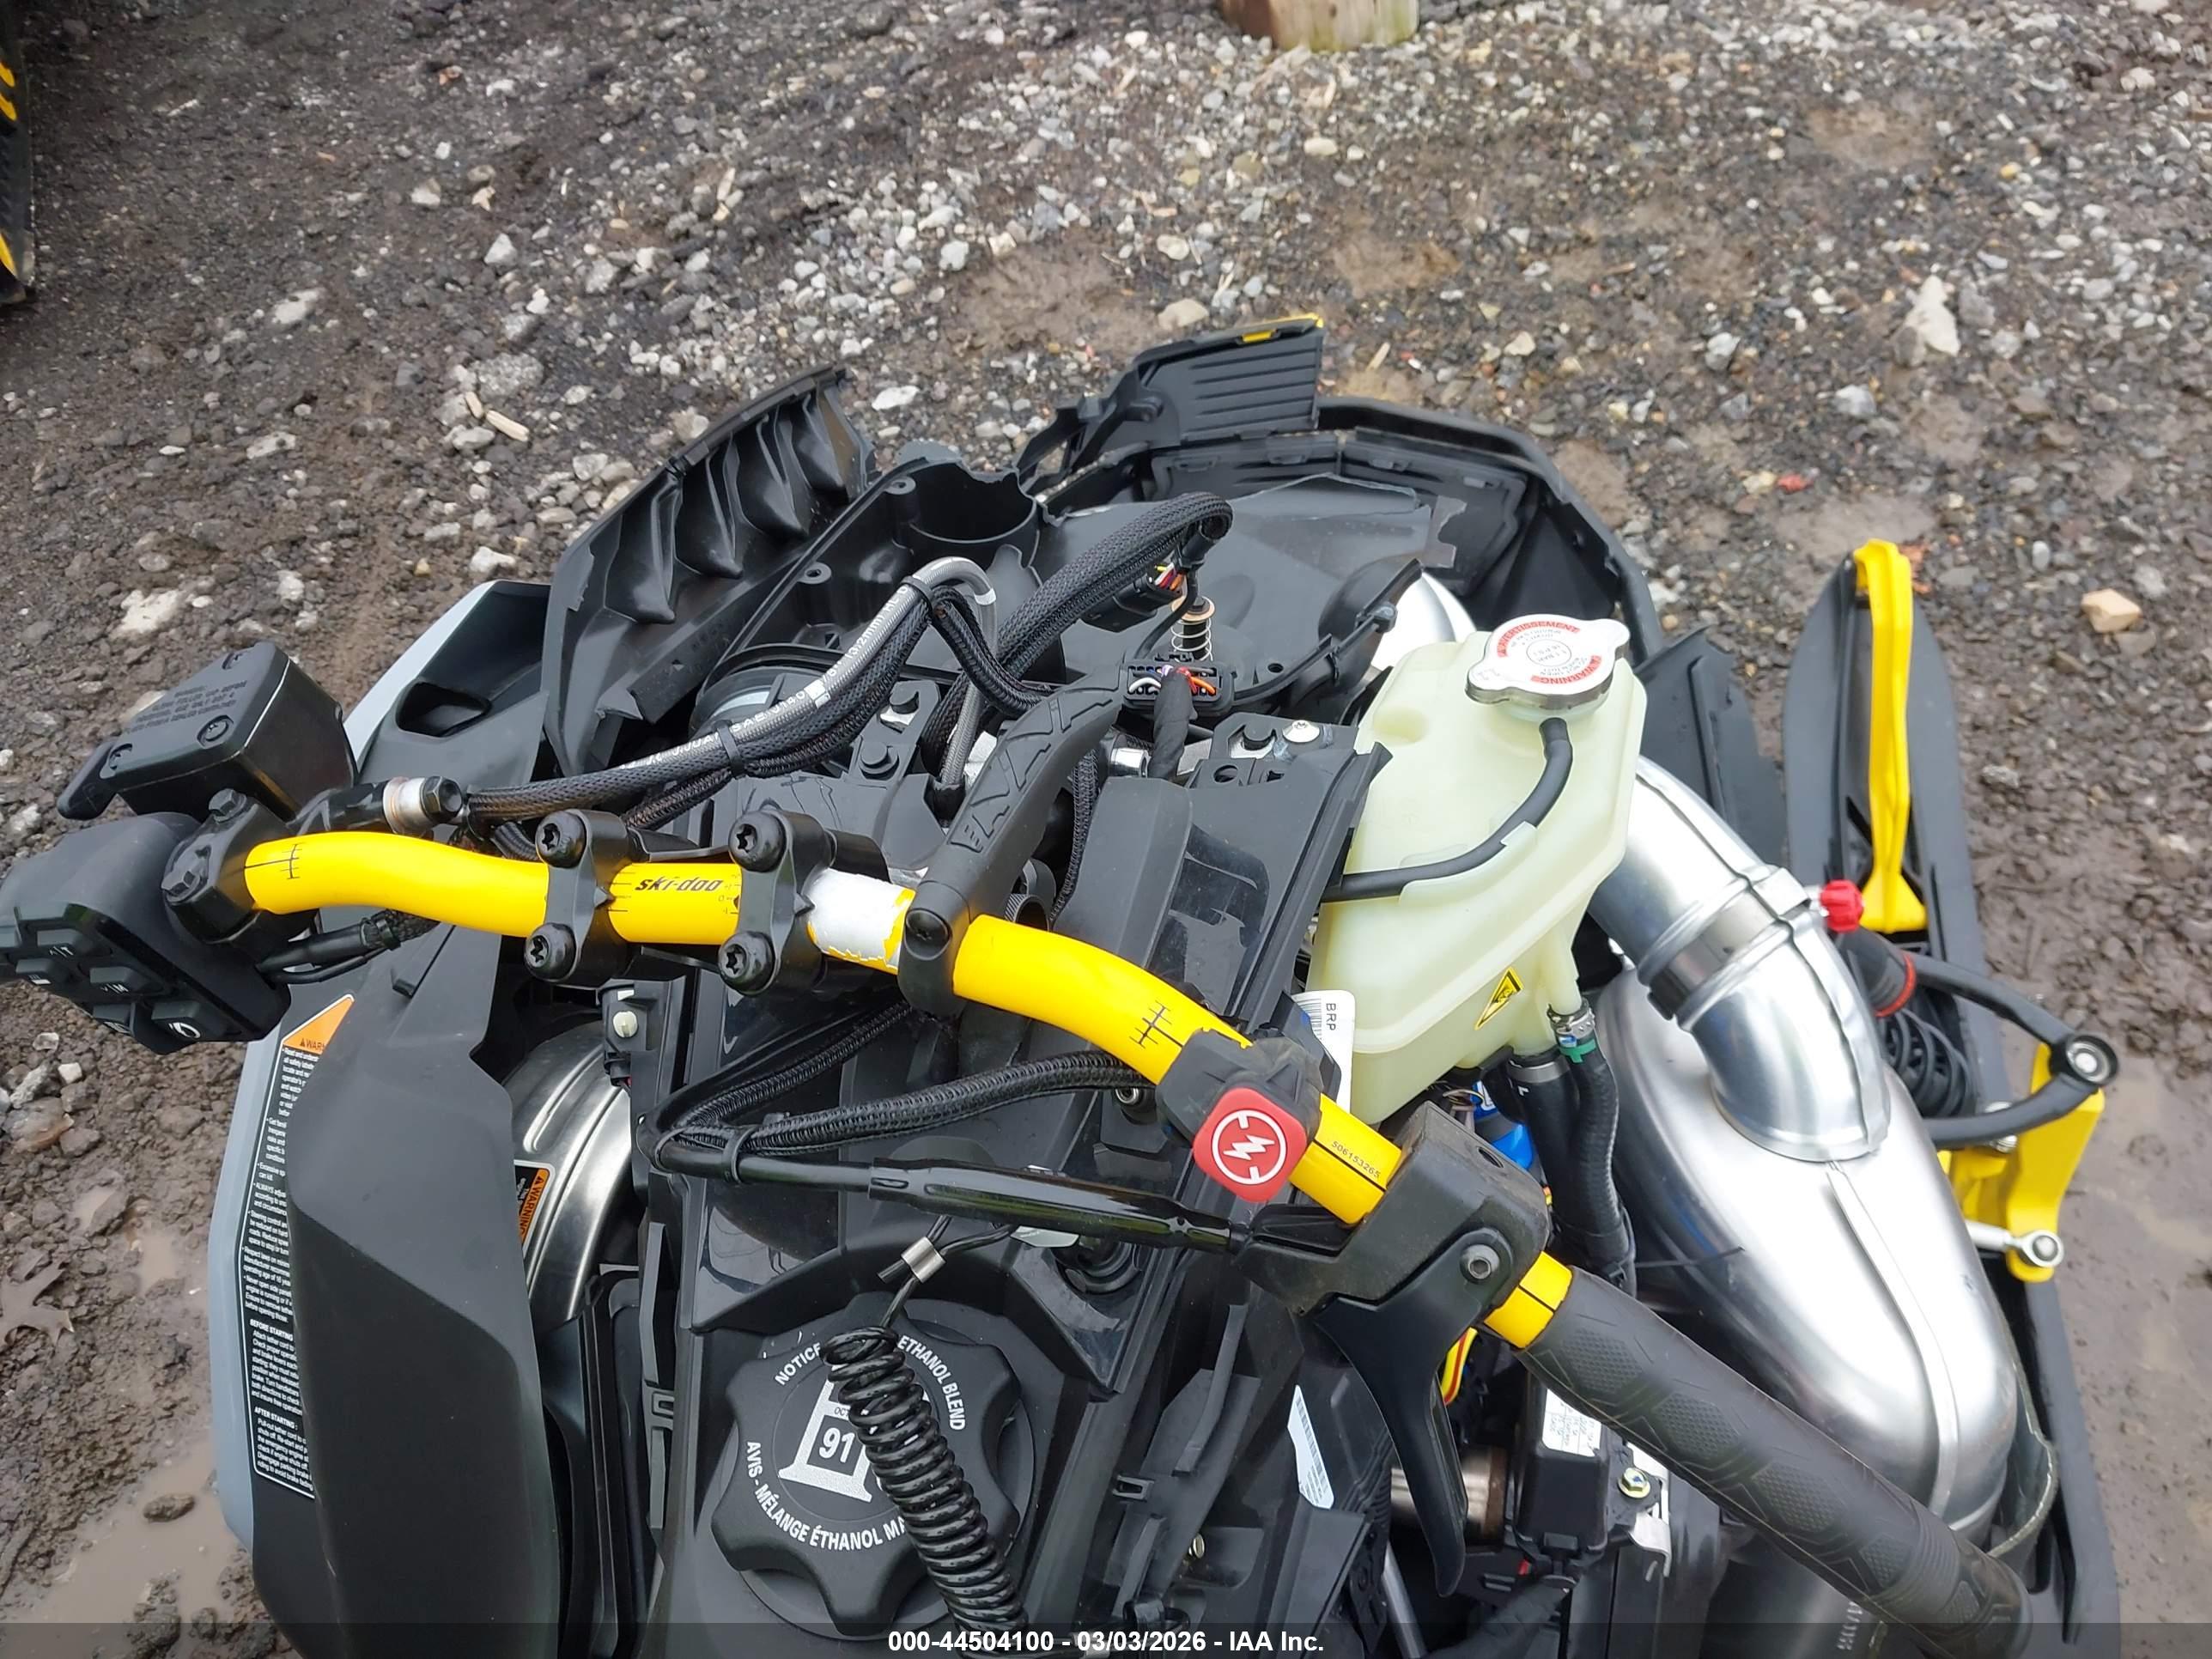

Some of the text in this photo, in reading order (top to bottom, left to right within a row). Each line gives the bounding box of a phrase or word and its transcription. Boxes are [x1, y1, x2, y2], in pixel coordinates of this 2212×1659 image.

[635, 876, 724, 891] ski-doo
[1326, 1003, 1337, 1031] BRP
[1332, 1140, 1382, 1180] 506153265
[897, 1334, 951, 1385] ETHANOL
[942, 1382, 966, 1431] BLEND
[254, 1406, 270, 1419] AFTER
[270, 1413, 295, 1430] STARTING
[747, 1441, 763, 1479] AVIS
[818, 1427, 855, 1463] 91
[754, 1483, 806, 1543] MÉLANGE
[810, 1524, 884, 1552] ÉTHANOL
